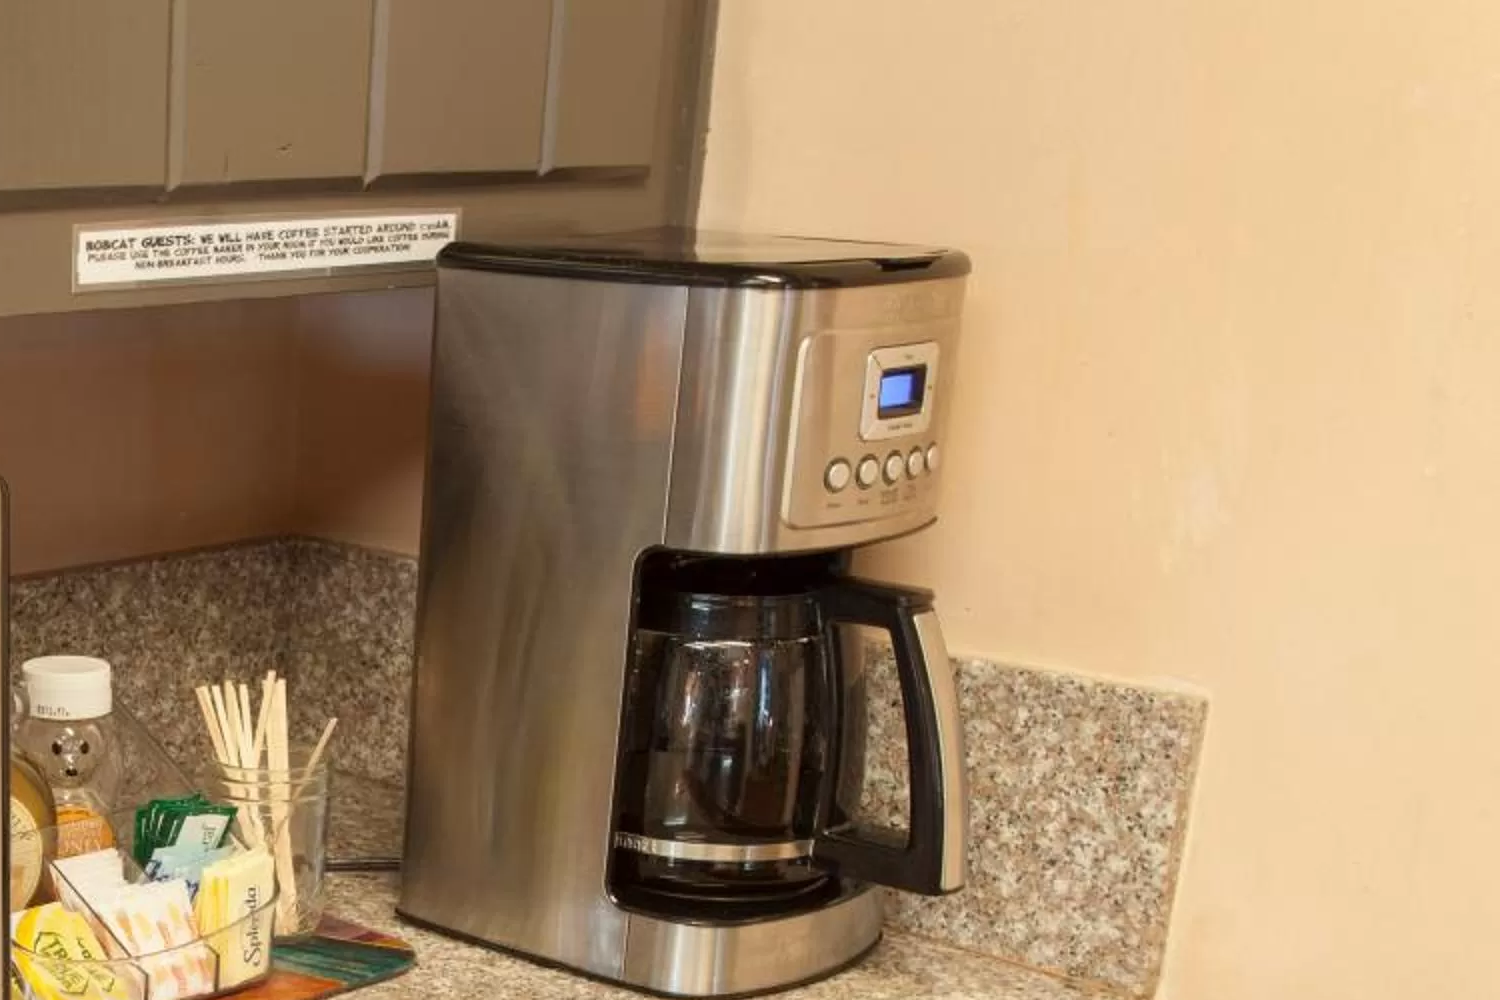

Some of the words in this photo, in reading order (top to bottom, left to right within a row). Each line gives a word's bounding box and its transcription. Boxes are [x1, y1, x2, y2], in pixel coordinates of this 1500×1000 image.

[85, 237, 136, 251] BOBCAT
[200, 234, 213, 244] WE
[218, 232, 241, 243] WILL
[245, 230, 274, 242] HAVE
[278, 227, 319, 240] COFFEE
